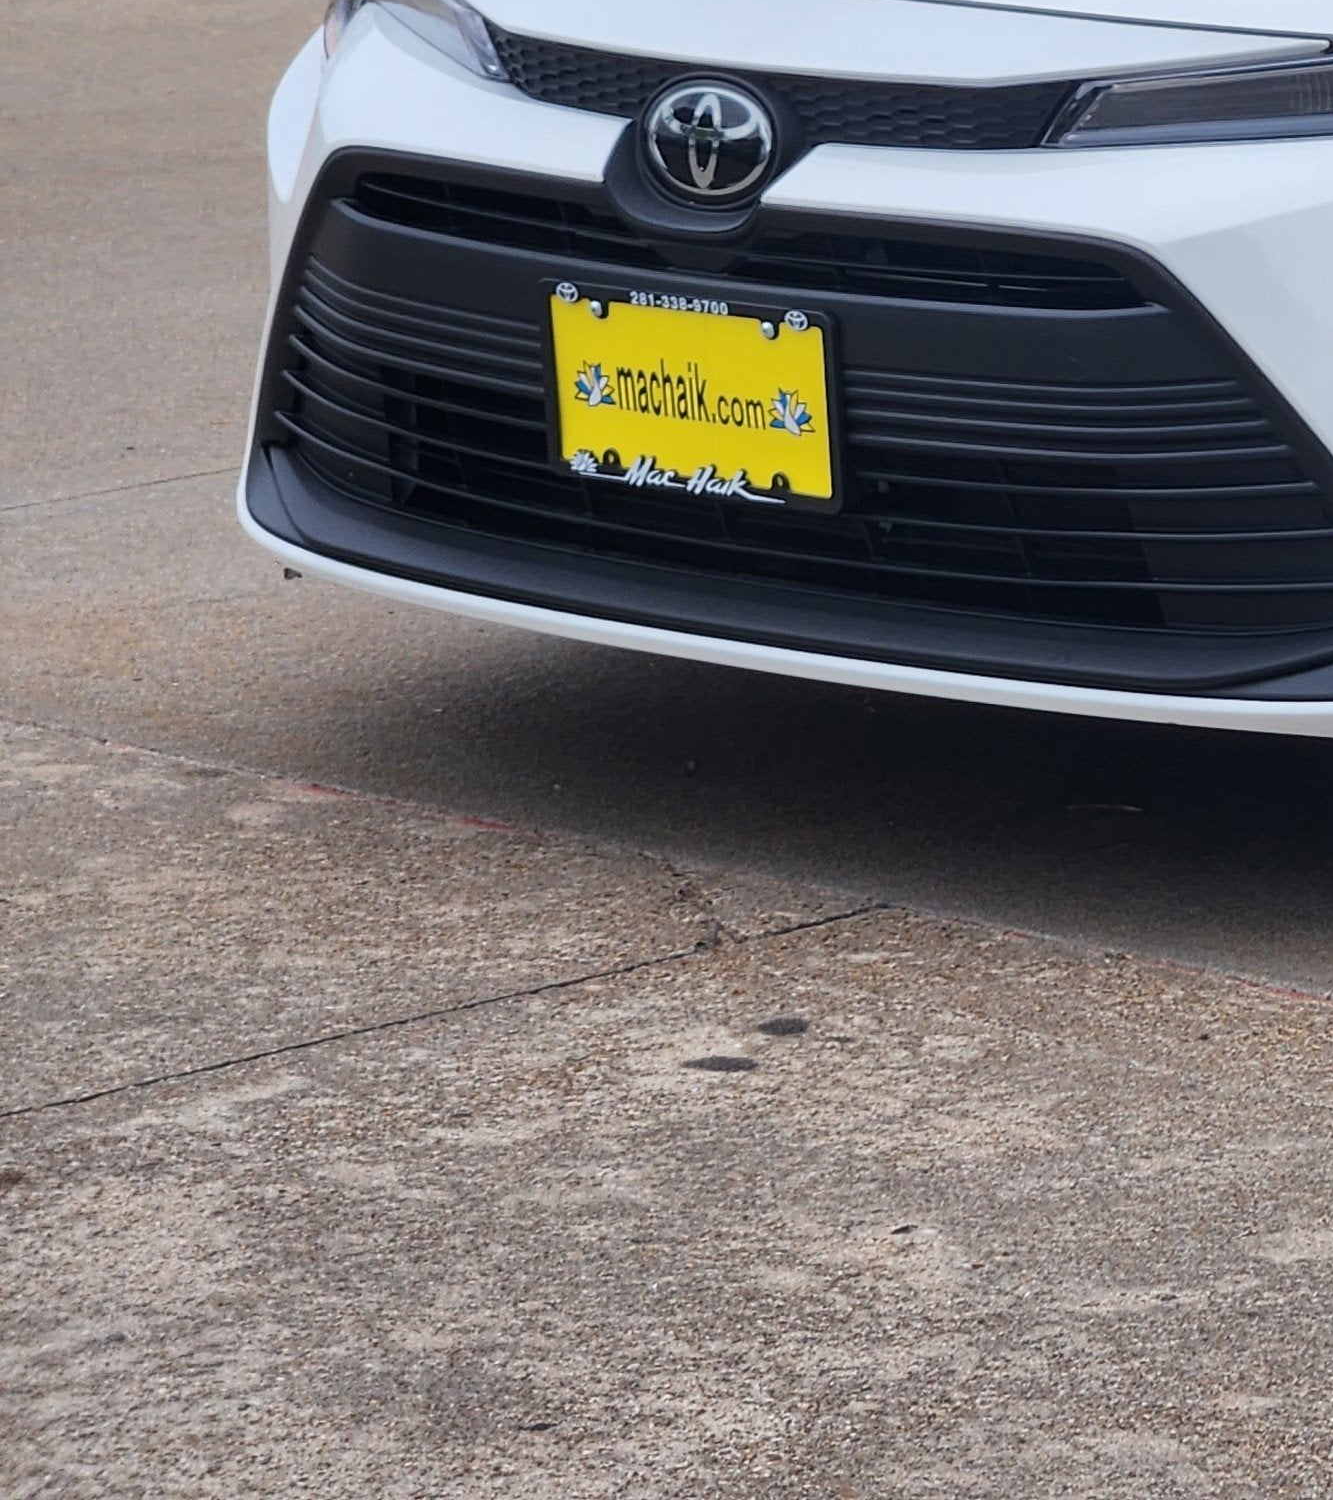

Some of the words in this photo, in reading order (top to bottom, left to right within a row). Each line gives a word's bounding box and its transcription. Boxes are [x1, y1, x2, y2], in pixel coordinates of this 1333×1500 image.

[615, 358, 767, 430] machaik.com
[625, 456, 682, 487] Mac
[686, 465, 752, 497] Haik
